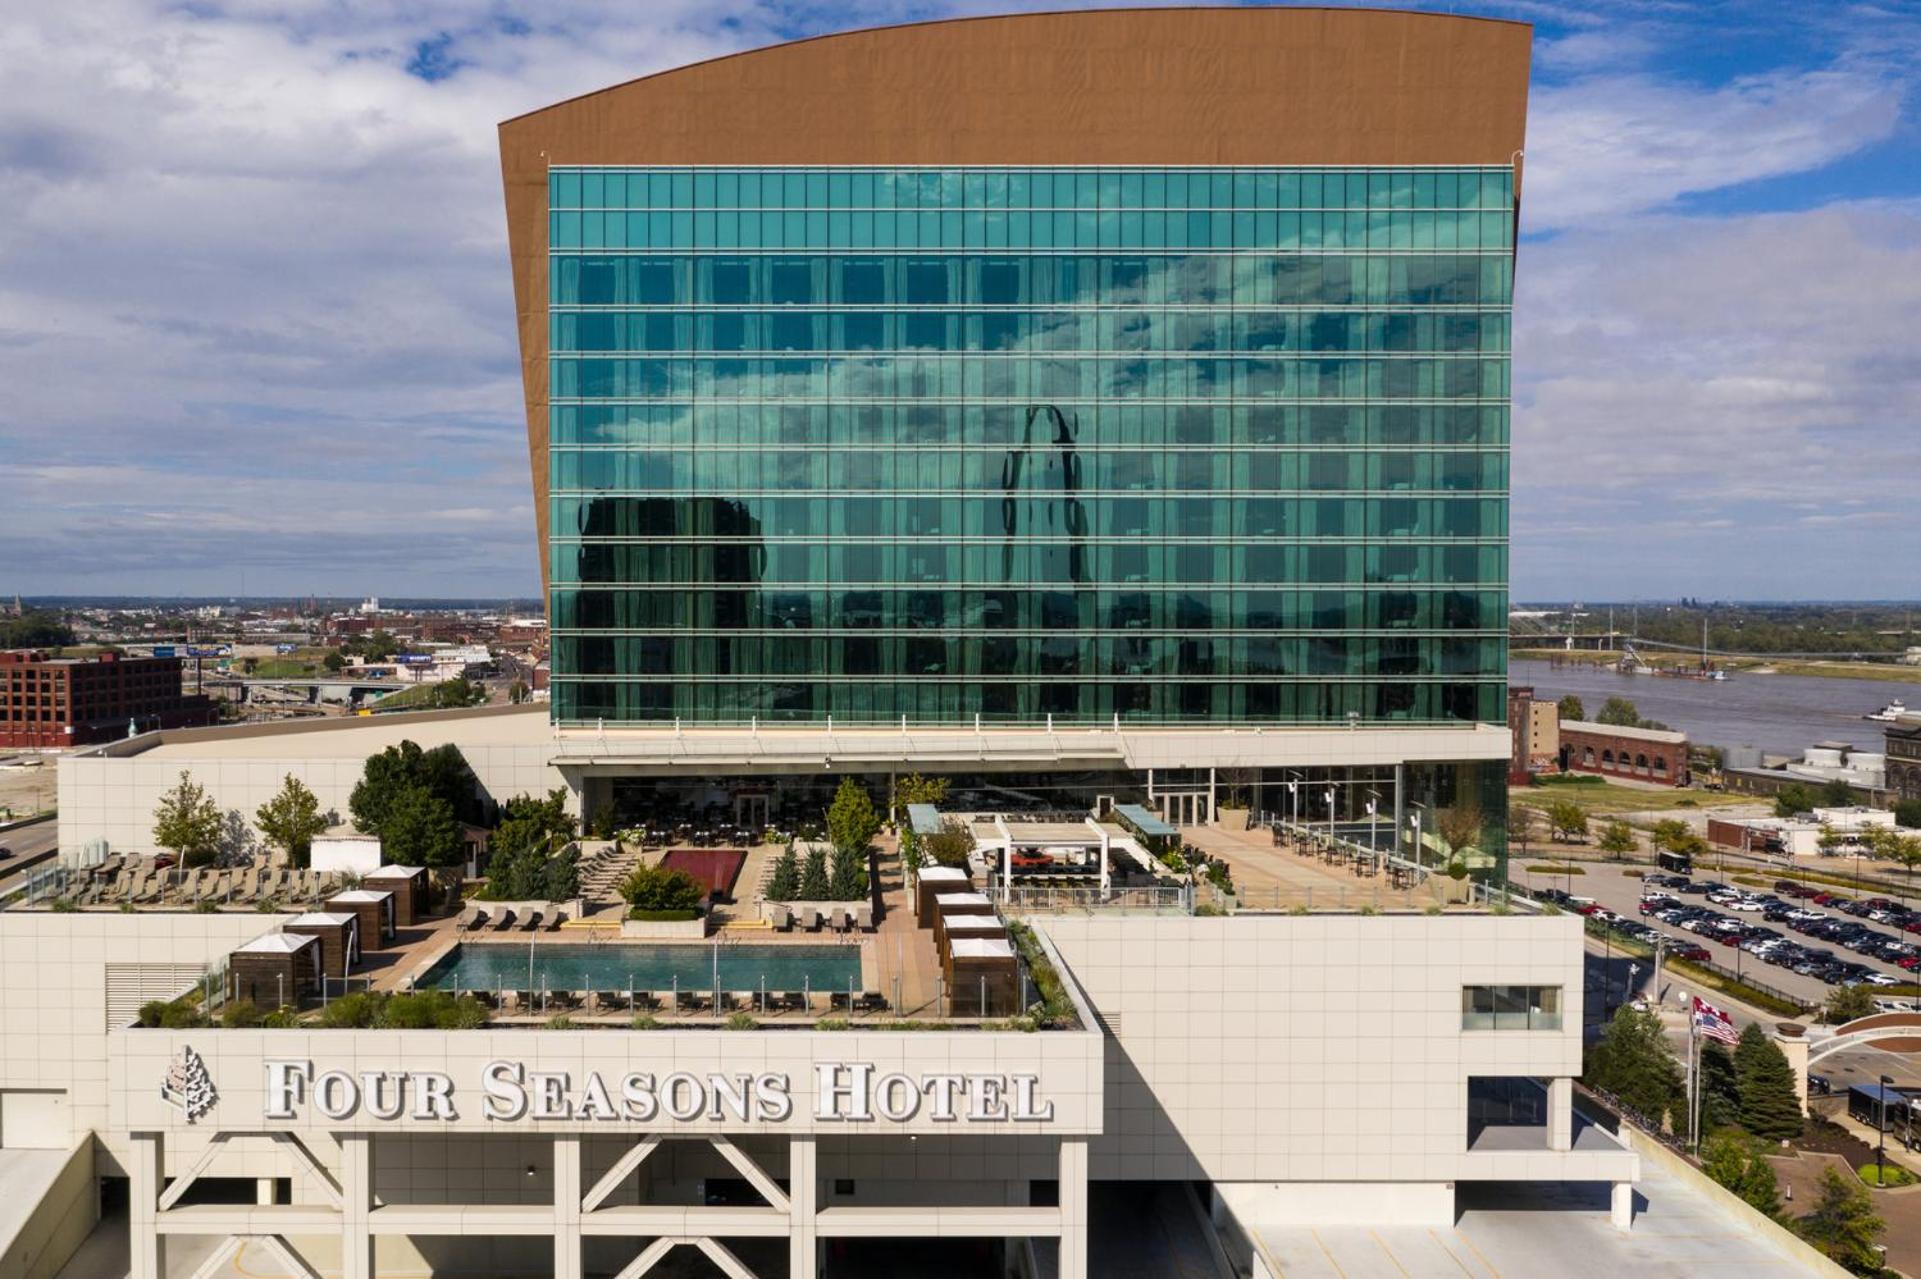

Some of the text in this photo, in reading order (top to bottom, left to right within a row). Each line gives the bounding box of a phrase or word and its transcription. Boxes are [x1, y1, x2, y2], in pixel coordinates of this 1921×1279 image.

[264, 1059, 1053, 1122] FOUR SEASONS HOTEL
